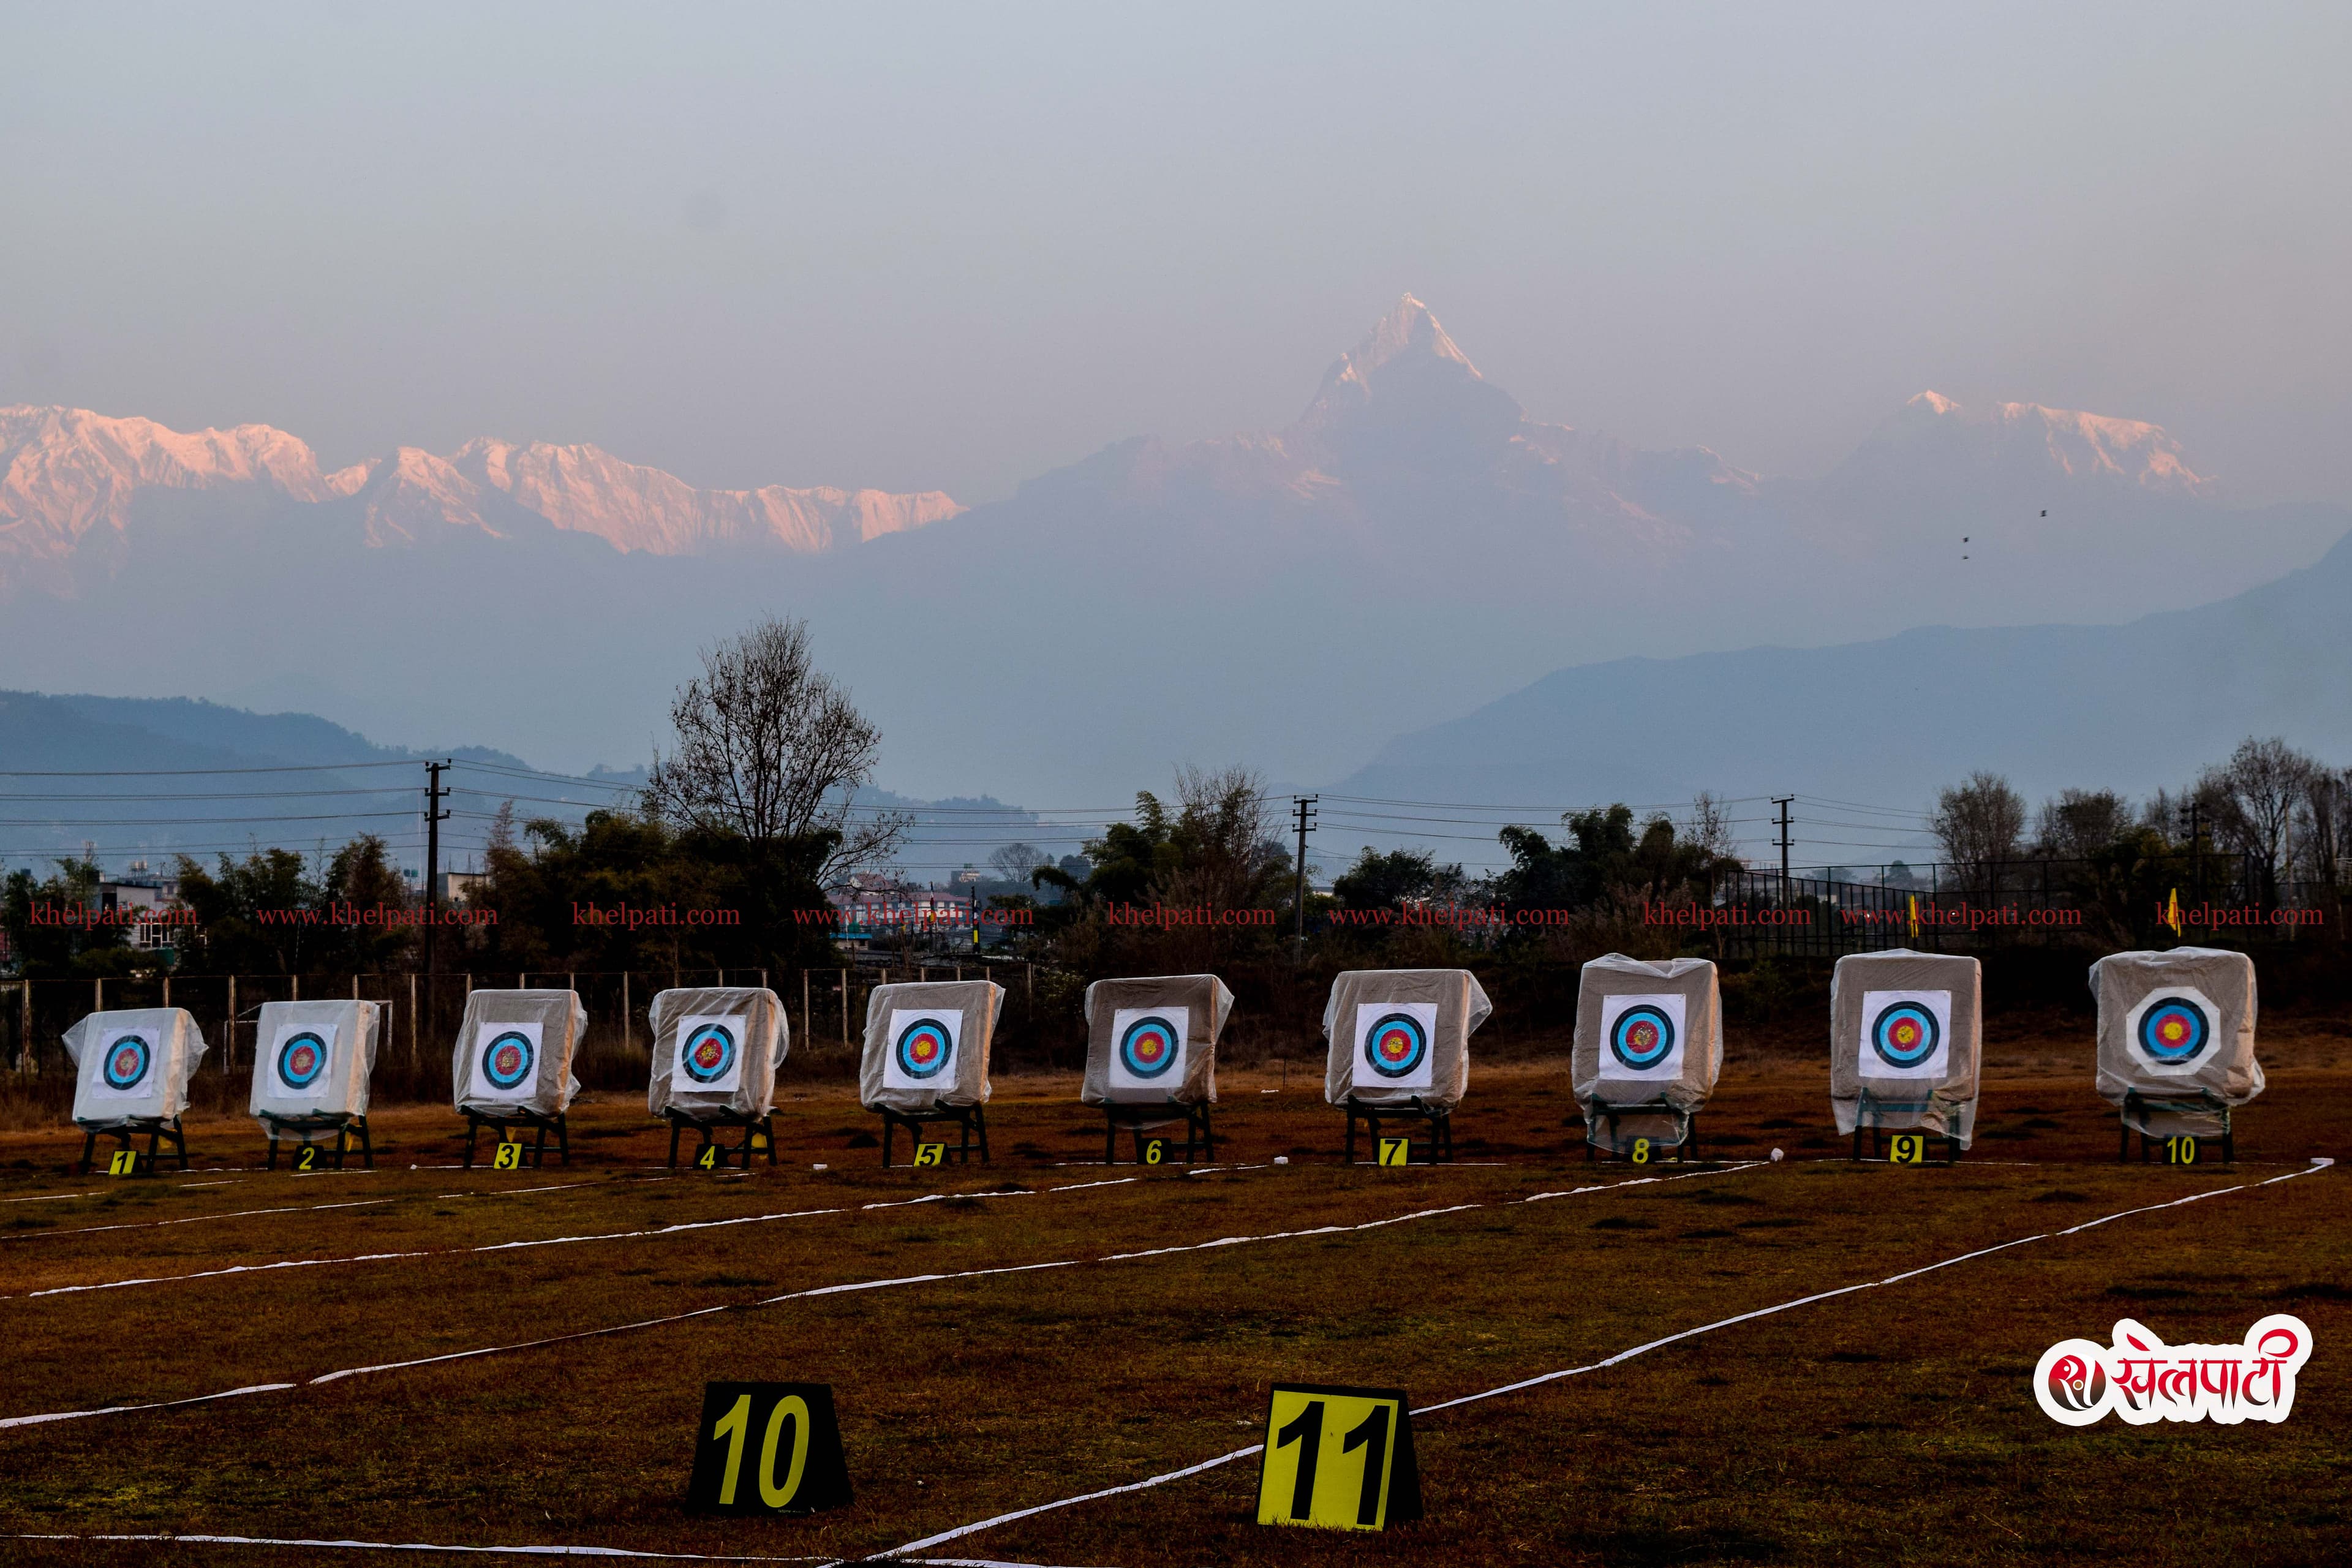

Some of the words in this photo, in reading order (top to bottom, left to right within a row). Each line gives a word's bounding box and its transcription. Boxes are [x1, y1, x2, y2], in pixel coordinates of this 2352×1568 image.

[299, 1147, 314, 1170] 2
[499, 1145, 513, 1167] 3
[700, 1146, 715, 1169] 4
[919, 1145, 937, 1166] 5
[1146, 1140, 1162, 1164] 6
[1385, 1140, 1402, 1164] 7
[1632, 1139, 1649, 1163] 8
[1896, 1136, 1915, 1163] 9
[2168, 1137, 2195, 1164] 10
[116, 1152, 128, 1174] 1
[714, 1394, 810, 1508] 10
[1277, 1400, 1390, 1525] 11
